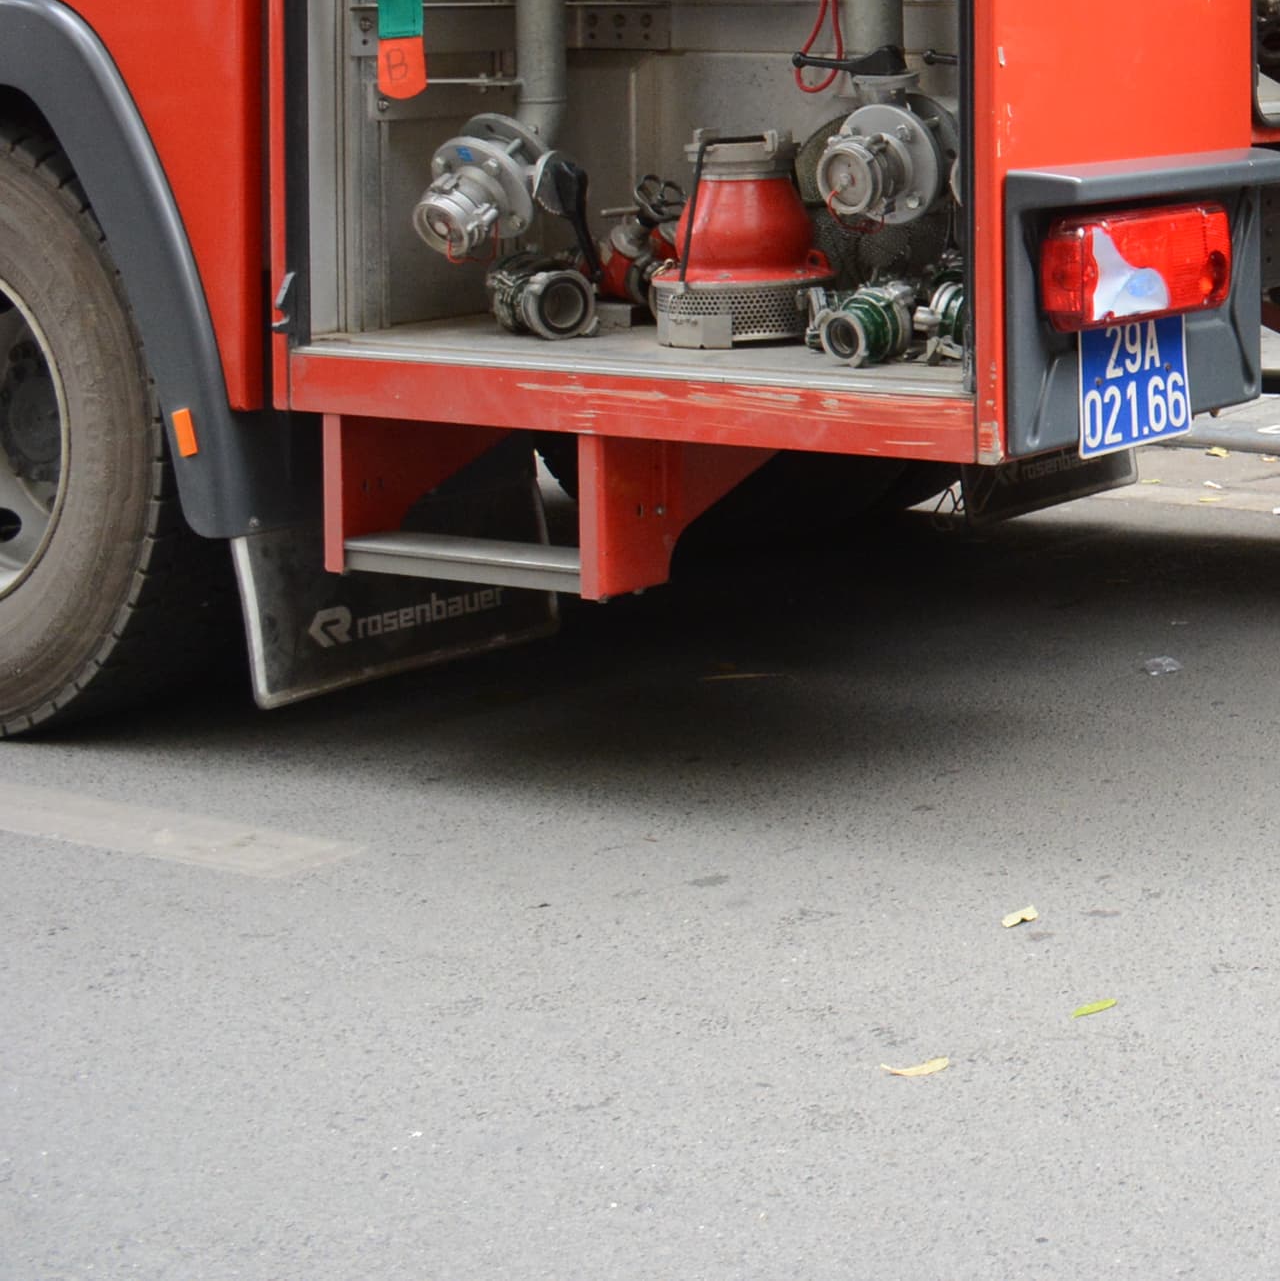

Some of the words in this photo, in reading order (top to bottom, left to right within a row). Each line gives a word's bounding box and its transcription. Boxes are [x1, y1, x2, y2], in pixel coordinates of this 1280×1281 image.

[1105, 320, 1160, 380] 29A
[1084, 372, 1186, 448] 021.66
[357, 586, 504, 638] rosenbauer
